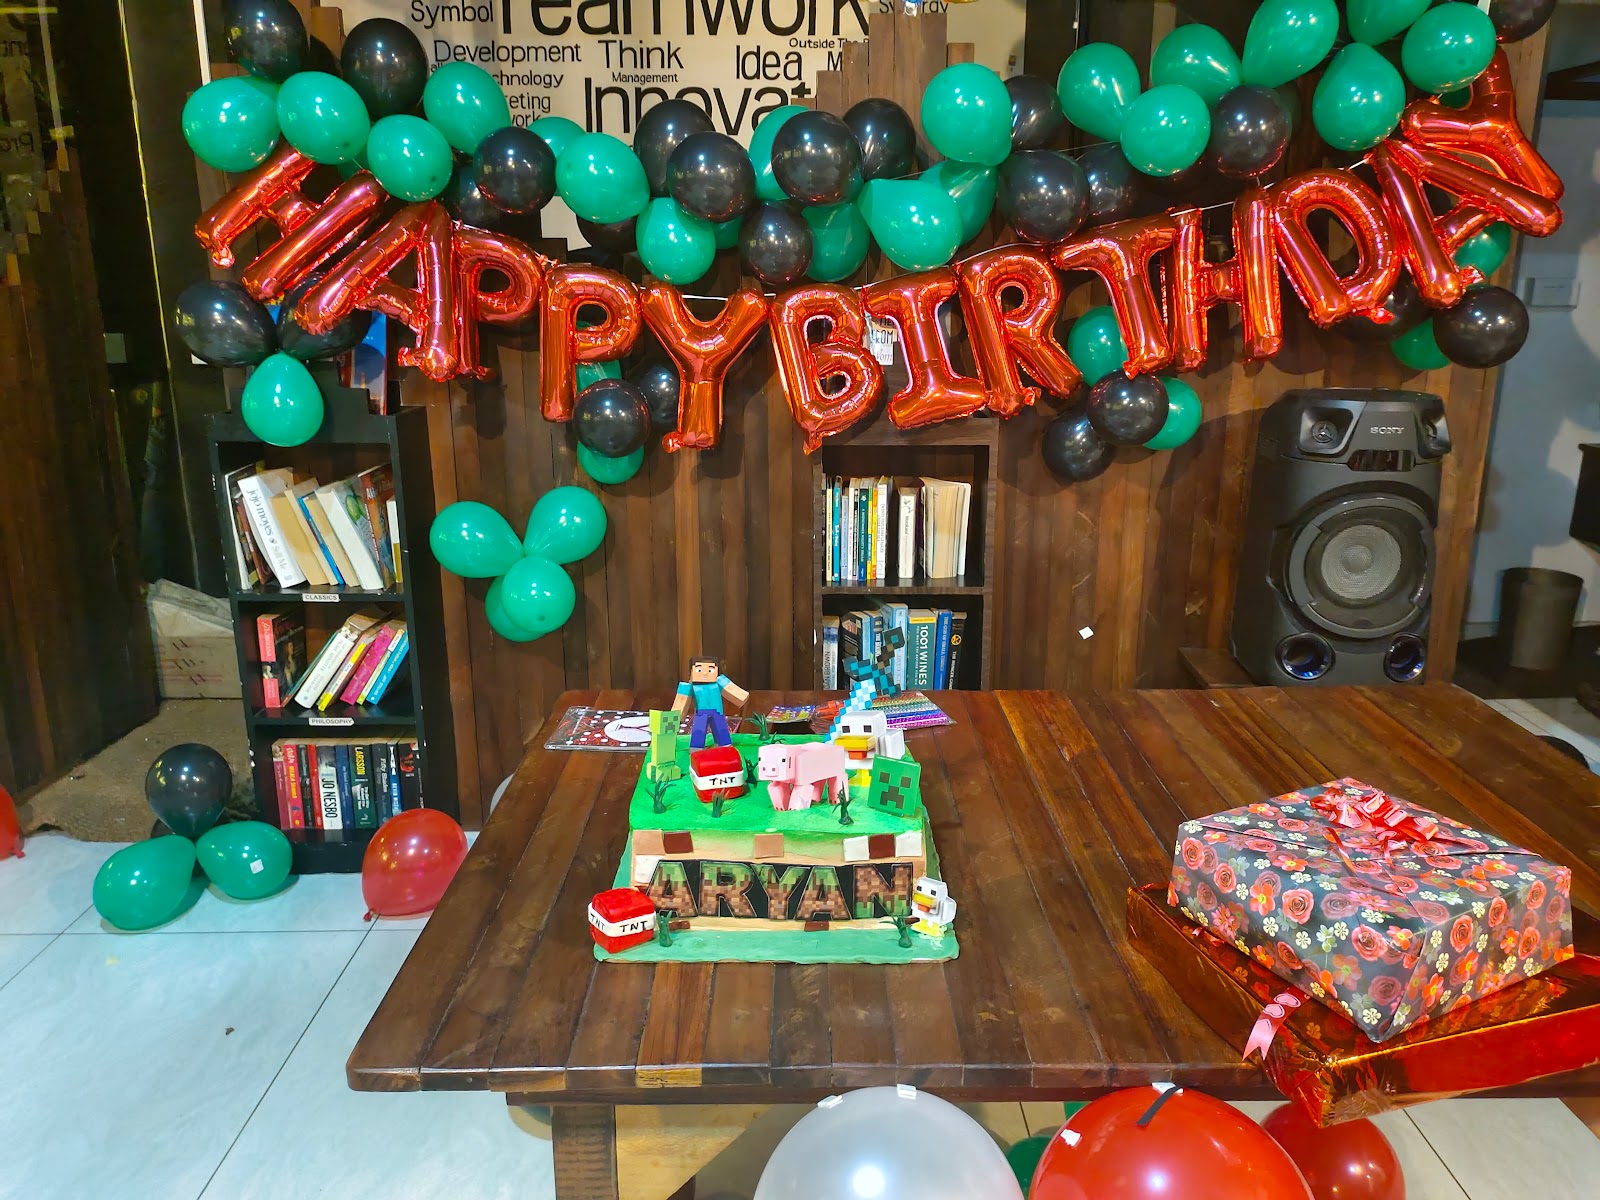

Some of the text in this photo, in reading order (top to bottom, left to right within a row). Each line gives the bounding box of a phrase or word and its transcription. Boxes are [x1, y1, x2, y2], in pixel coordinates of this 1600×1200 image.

[411, 0, 494, 29] Symbol
[433, 40, 582, 68] Development
[597, 39, 684, 69] Think
[789, 38, 835, 49] Outside
[736, 45, 803, 81] Idea
[612, 72, 678, 85] Management
[195, 45, 1564, 455] HAPPY BIRTHDAY
[1370, 426, 1404, 434] SONY
[246, 489, 261, 507] jojo
[257, 507, 274, 536] moyes
[919, 625, 929, 649] 1001
[918, 651, 928, 685] WINES
[311, 718, 353, 726] PHILOSOPHY
[354, 746, 366, 775] LARSSON
[709, 776, 736, 785] TNT
[321, 778, 338, 818] JO NESBO
[645, 860, 914, 920] ARYAN
[590, 912, 606, 931] TNT
[619, 920, 648, 932] TNT
